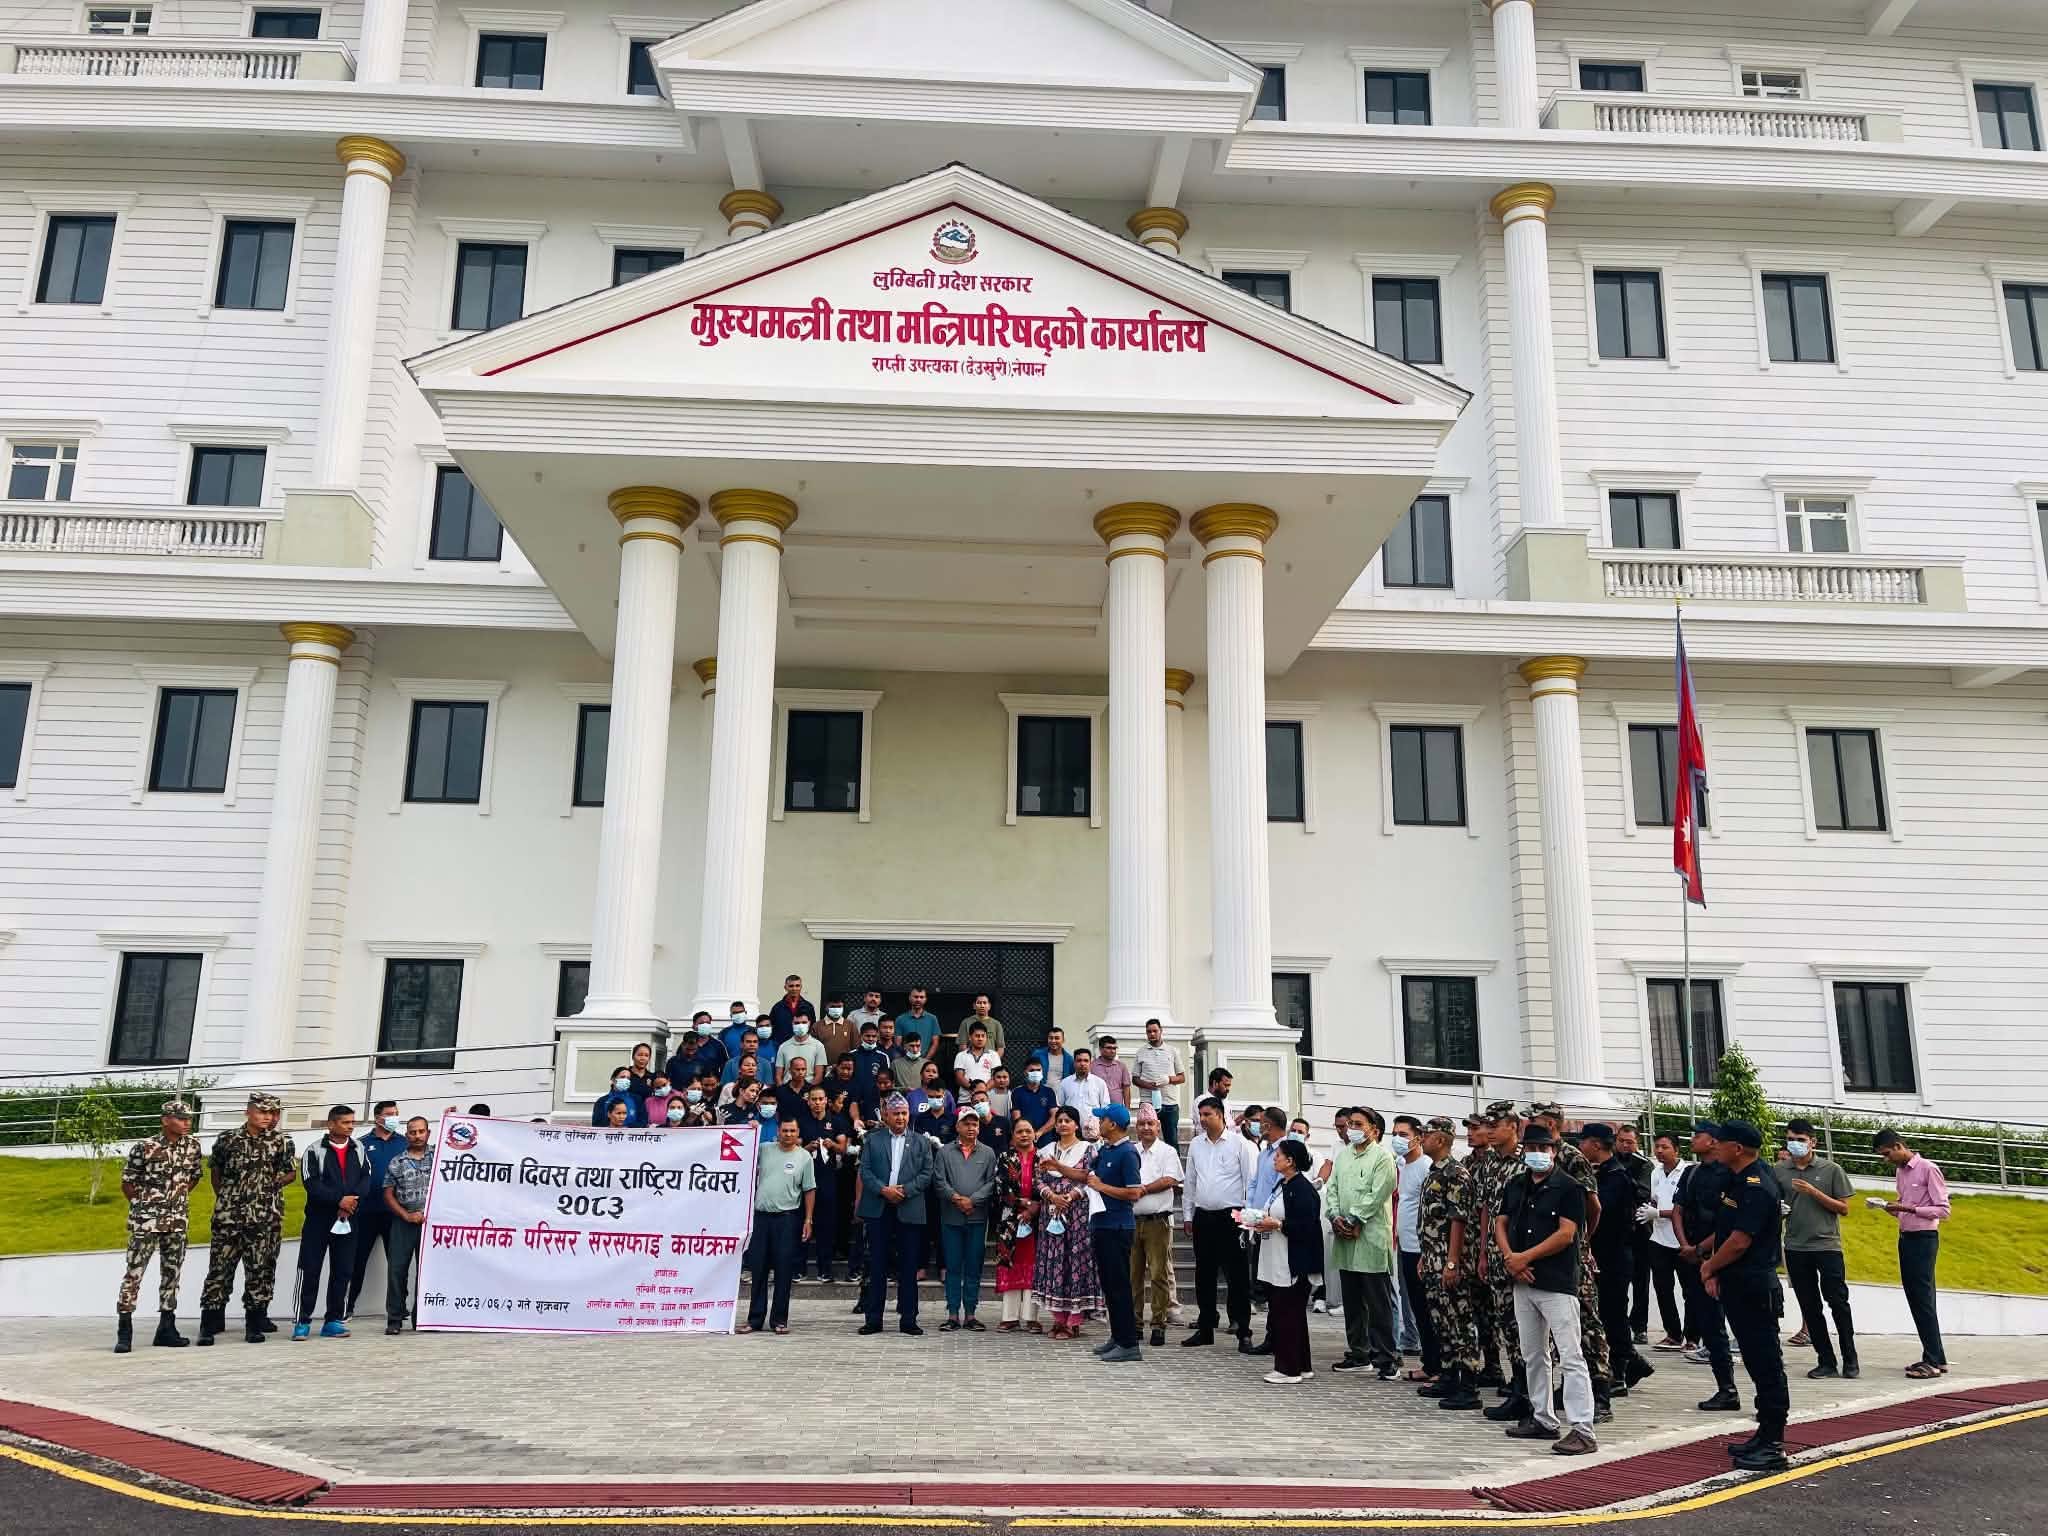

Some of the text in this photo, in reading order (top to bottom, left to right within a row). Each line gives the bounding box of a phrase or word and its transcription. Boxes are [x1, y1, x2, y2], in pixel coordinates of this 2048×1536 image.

[872, 267, 1034, 293] लुम्बिनी प्रदेश सरकार
[690, 296, 1209, 358] मुख्यमन्त्री तथा मन्त्रिपरिषद्को कार्यालय
[872, 354, 906, 374] राप्ती
[908, 358, 959, 375] उपत्यका
[439, 1153, 741, 1196] संविधान दिवस तथा राष्ट्रिय दिवस,
[556, 1194, 624, 1219] २०८३
[431, 1218, 740, 1258] प्रशासनिक परिसर सरसफाइ कार्यक्रम
[517, 1297, 532, 1311] गते
